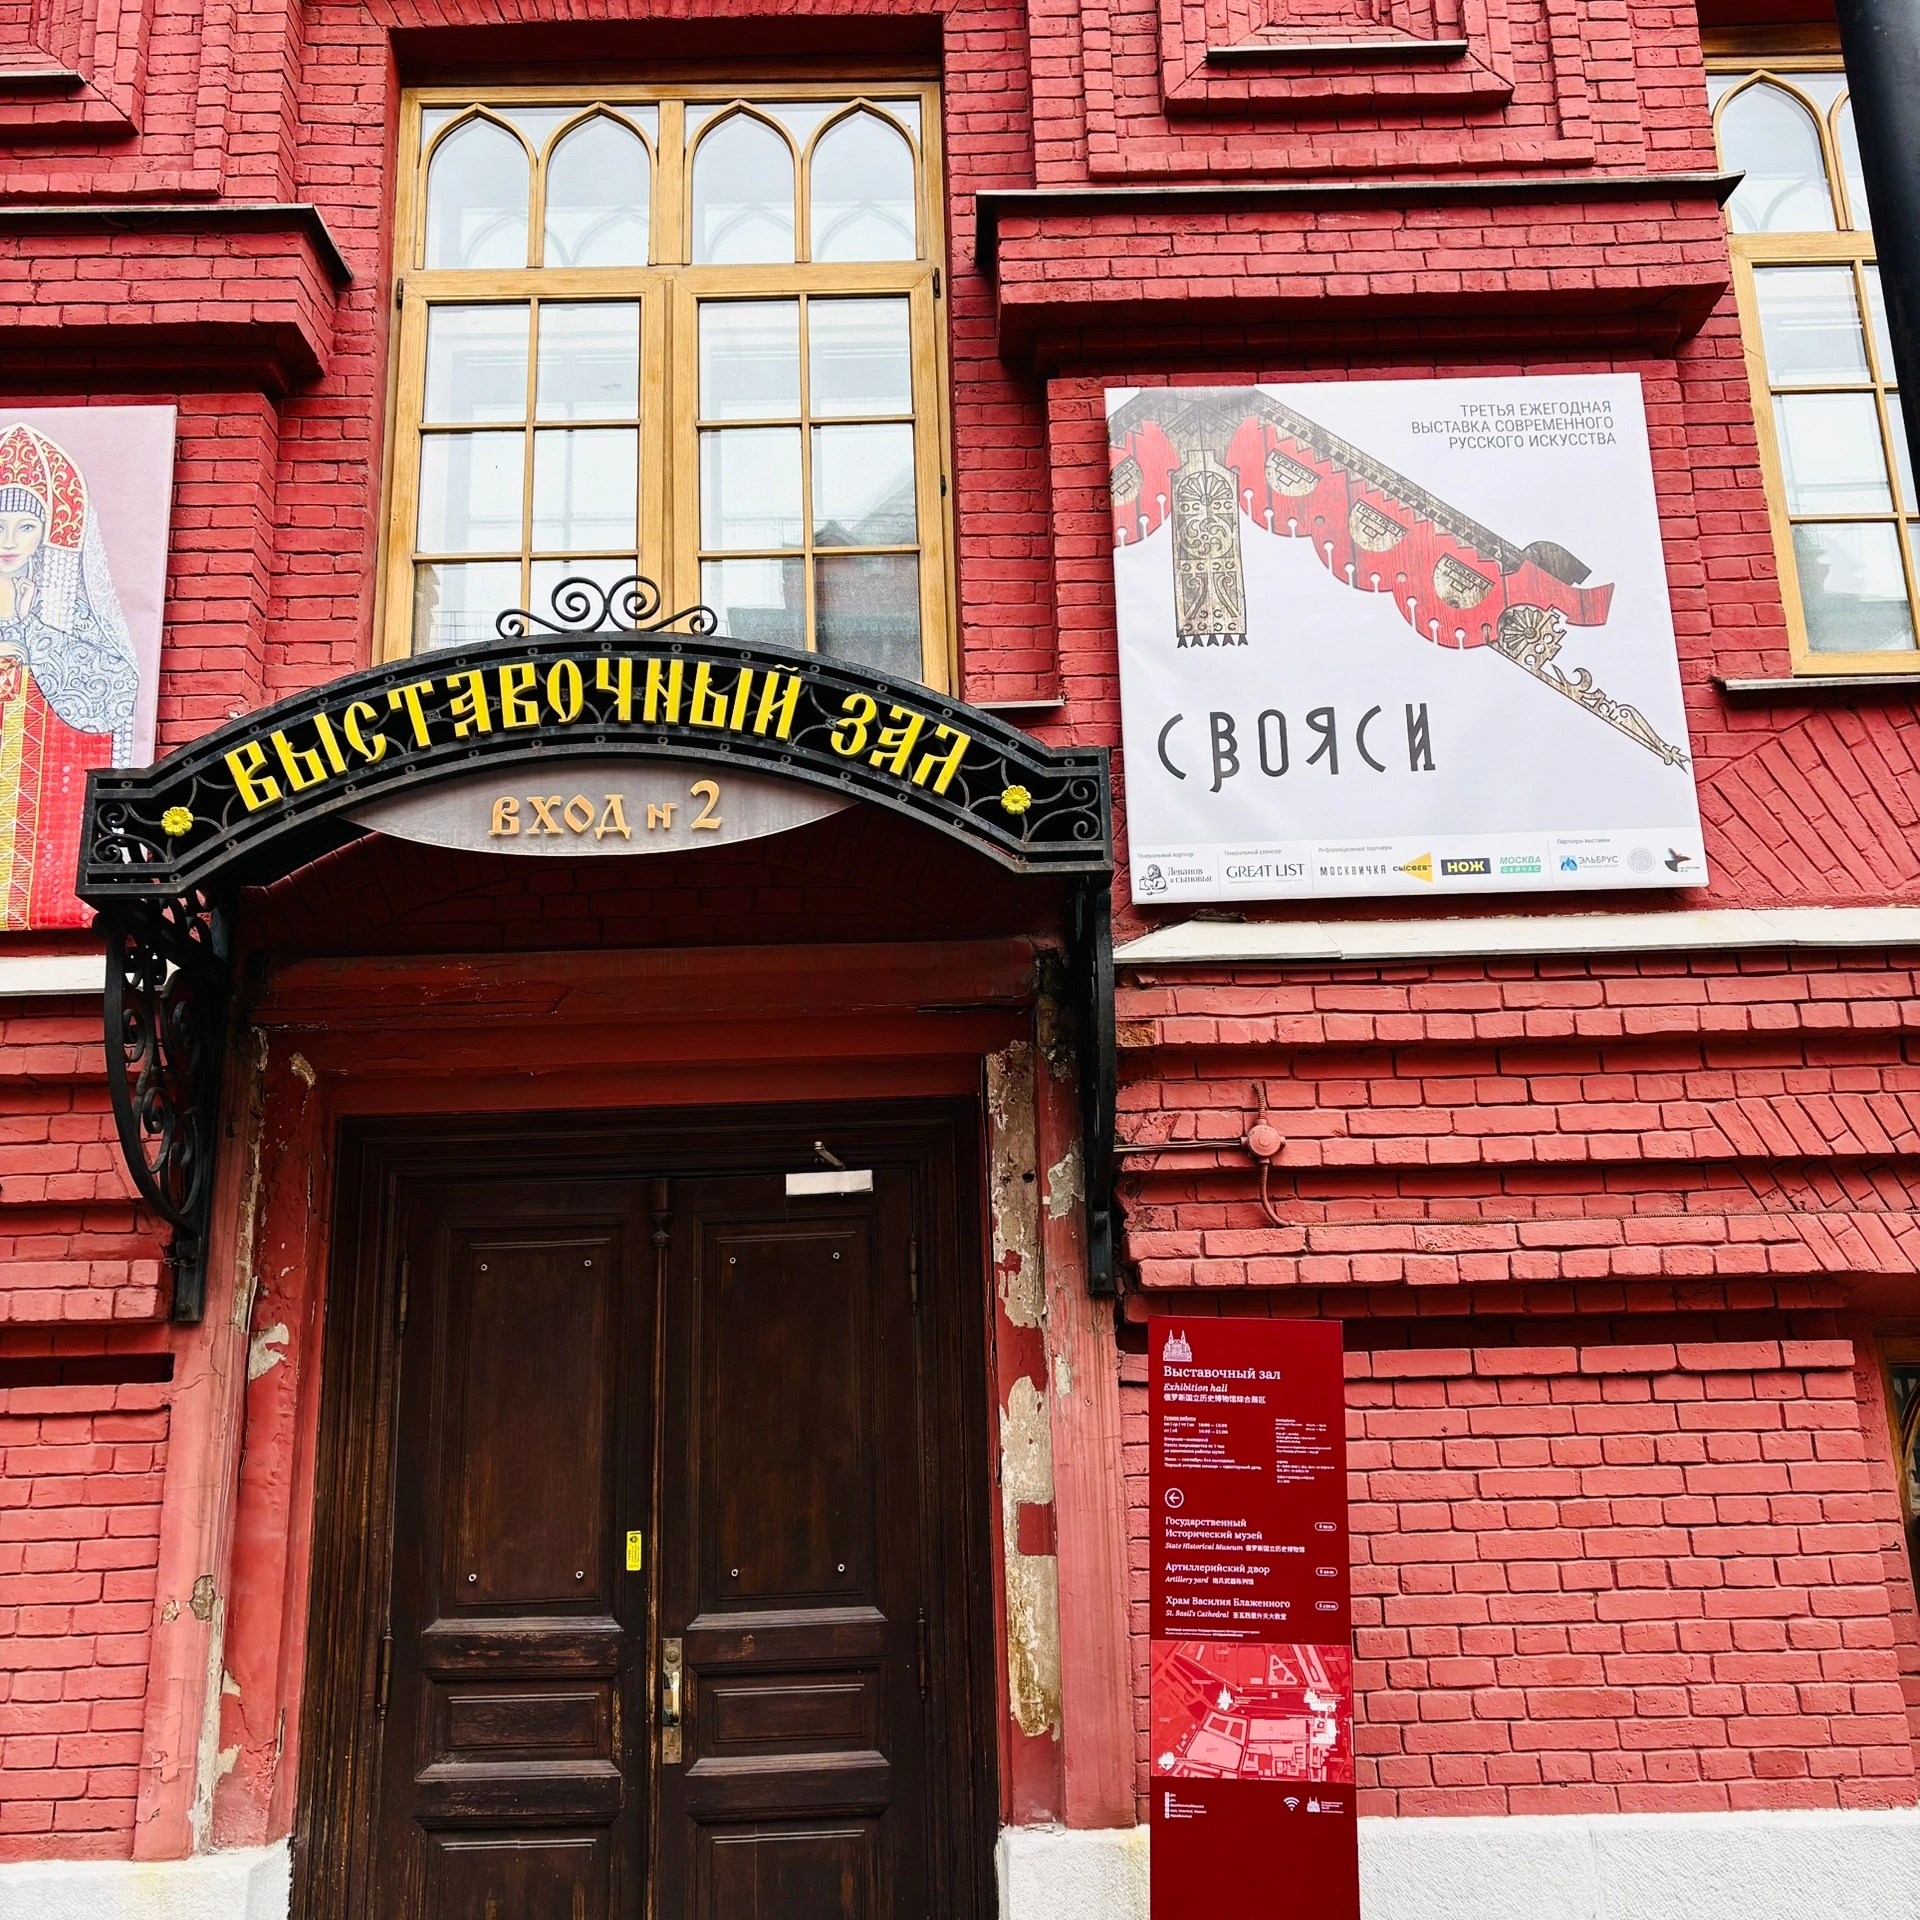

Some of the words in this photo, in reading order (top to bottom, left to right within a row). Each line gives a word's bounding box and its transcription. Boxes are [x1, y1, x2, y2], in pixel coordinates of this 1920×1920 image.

[1460, 403, 1515, 417] ТРЕТЬЯ
[1519, 400, 1611, 416] ЕЖЕГОДНАЯ
[1411, 420, 1491, 434] ВЫСТАВКА
[1495, 416, 1614, 433] СОВРЕМЕННОГО
[1449, 435, 1524, 449] РУССКОГО
[1529, 432, 1617, 447] ИСКУССТВА
[224, 658, 801, 813] ВЫСТАВОЧНЫЙ
[830, 692, 972, 796] ЗАЛ
[1157, 702, 1436, 793] СВОЯСИ
[488, 793, 632, 840] ВХОД
[690, 780, 723, 829] 2
[1499, 856, 1541, 865] МОСКВА
[1578, 855, 1619, 864] ЭЛЬБРУС
[1167, 867, 1203, 876] Леванов
[1226, 864, 1272, 878] GREAT
[1275, 863, 1305, 877] LIST
[1320, 864, 1386, 876] МОСКВИЧКА
[1447, 860, 1485, 873] НОЖ
[1163, 1365, 1256, 1379] Выставочный
[1259, 1370, 1281, 1380] зал
[1163, 1382, 1208, 1392] Exhibition
[1210, 1383, 1228, 1392] hall
[1165, 1516, 1247, 1528] Государственный
[1165, 1528, 1232, 1540] Исторический
[1234, 1530, 1263, 1541] музей
[1182, 1542, 1215, 1550] Historical
[1165, 1561, 1246, 1574] Артиллерийский
[1246, 1566, 1270, 1576] двор
[1164, 1575, 1193, 1585] Artillery
[1193, 1576, 1209, 1585] yard
[1165, 1595, 1190, 1607] Храм
[1192, 1596, 1231, 1606] Василия
[1233, 1597, 1291, 1608] Блаженного
[1165, 1609, 1174, 1617] St.
[1196, 1610, 1230, 1619] Cathedral
